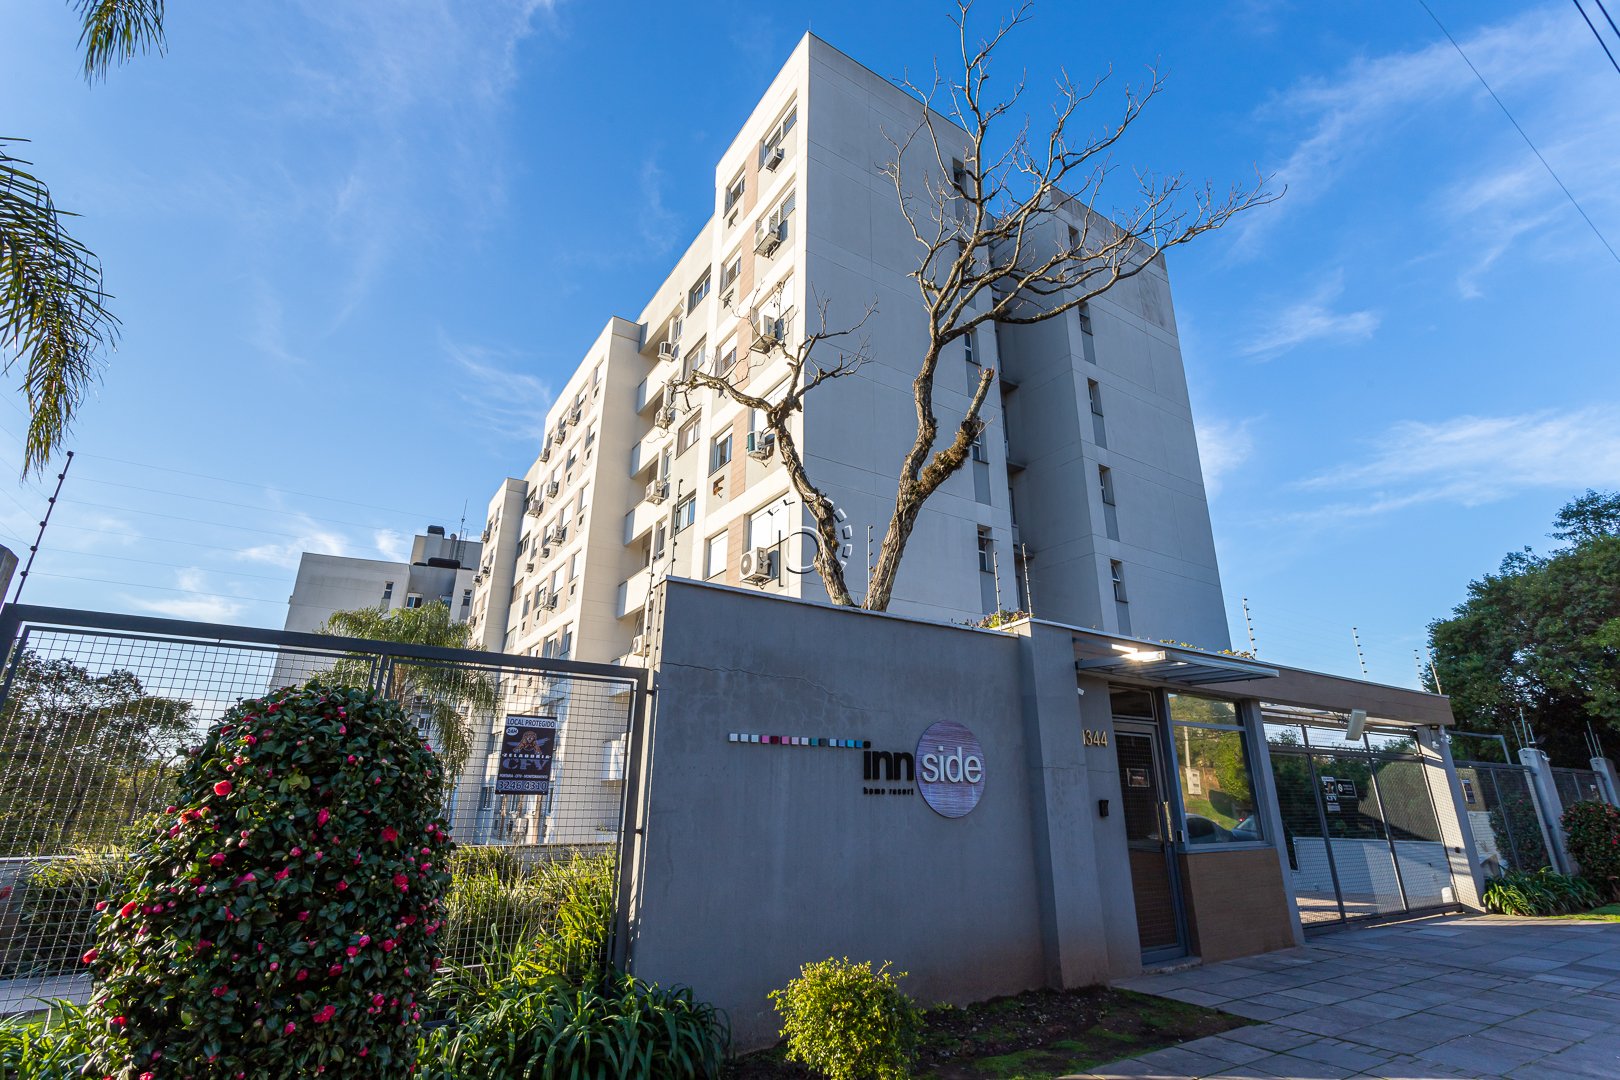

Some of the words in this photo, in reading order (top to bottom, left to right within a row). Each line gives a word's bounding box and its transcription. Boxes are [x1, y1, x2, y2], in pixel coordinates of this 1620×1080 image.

[507, 718, 524, 726] LOCAL
[525, 719, 554, 728] PROTEGIDO
[1082, 729, 1108, 747] 1344
[503, 758, 548, 770] CFV
[864, 741, 914, 781] inn
[921, 746, 982, 784] side
[524, 780, 547, 790] 4310
[864, 786, 886, 795] home
[889, 788, 914, 796] resort
